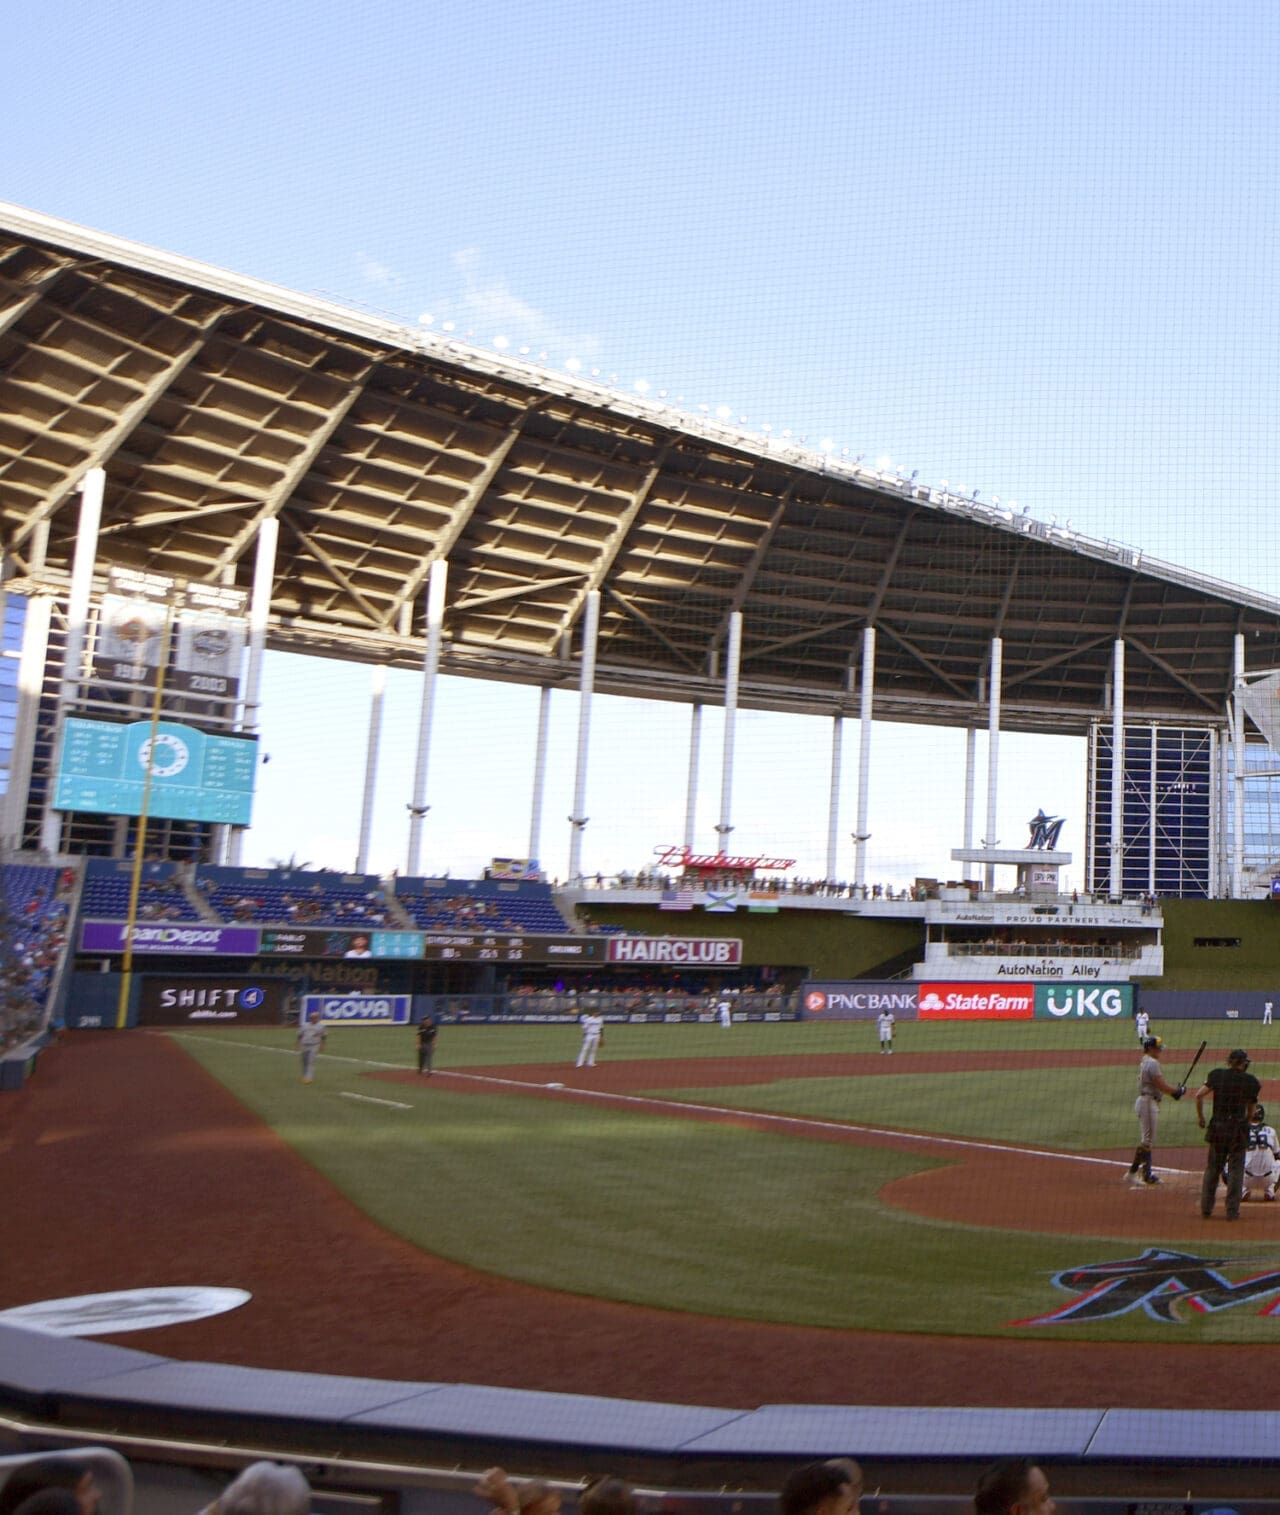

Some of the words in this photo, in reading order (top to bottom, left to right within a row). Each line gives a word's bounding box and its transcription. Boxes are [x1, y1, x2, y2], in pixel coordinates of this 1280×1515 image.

[1006, 915, 1042, 923] PROUD
[1048, 916, 1099, 924] PARTNERS
[615, 940, 730, 961] HAIRCLUB
[997, 964, 1063, 976] AutoNation
[1072, 964, 1100, 977] Alley
[325, 1001, 391, 1018] GOYA
